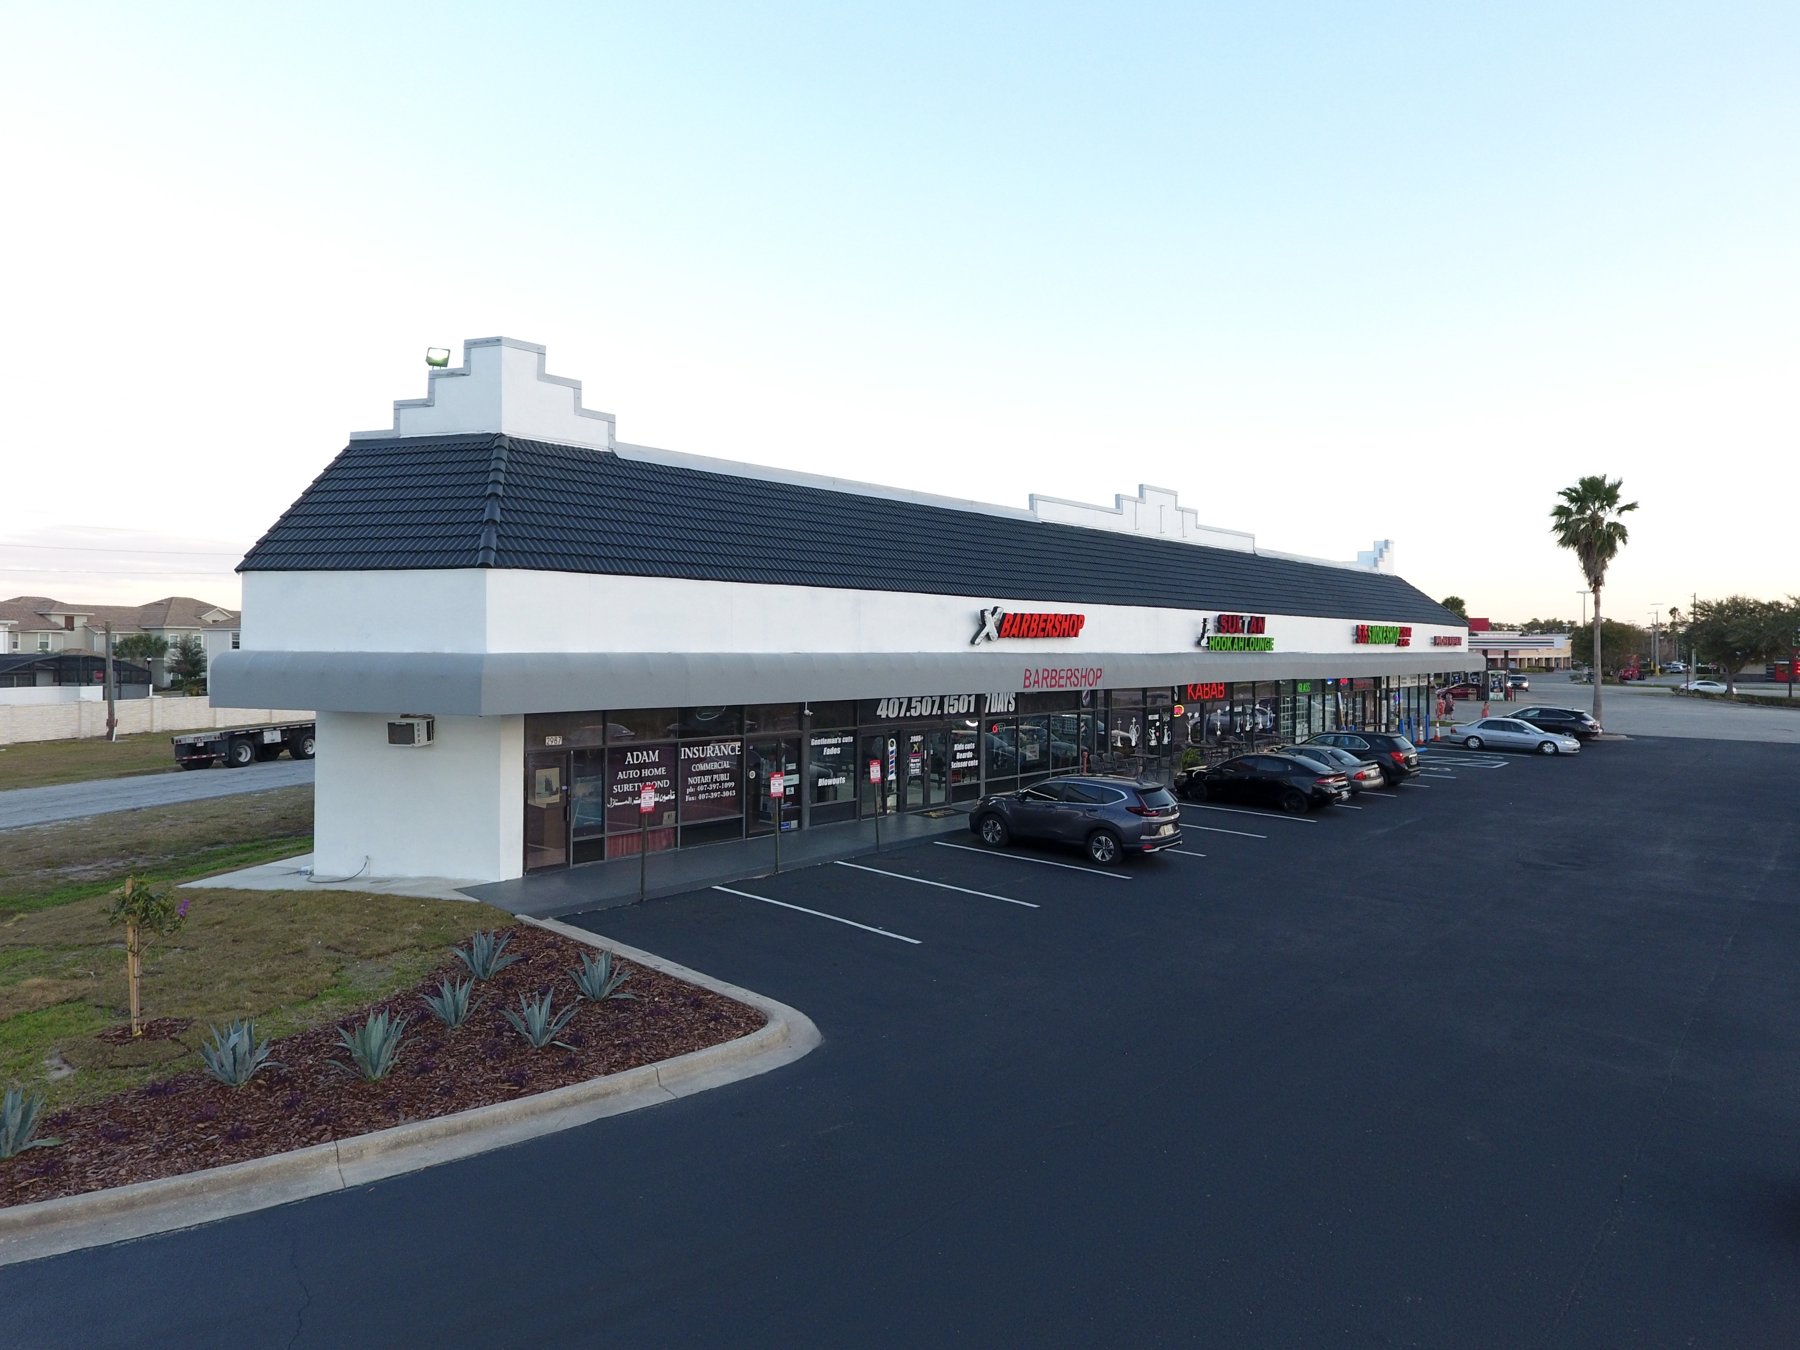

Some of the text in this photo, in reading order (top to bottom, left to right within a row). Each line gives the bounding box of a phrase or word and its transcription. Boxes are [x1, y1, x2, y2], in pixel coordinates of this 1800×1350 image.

[999, 613, 1086, 638] BARBERSHOP
[1218, 615, 1265, 634] SULTAN
[1208, 637, 1274, 652] HOOKAH LOUNGE
[1023, 668, 1102, 689] BARBERSHOP
[1187, 683, 1225, 700] KABAB
[876, 695, 974, 718] 407.507.1501
[624, 750, 659, 765] ADAM
[681, 744, 741, 759] INSURANCE
[616, 767, 667, 780] AUTO HOME
[691, 761, 730, 772] COMMERCIAL
[687, 775, 712, 785] NOTARY
[612, 783, 645, 793] SURETY
